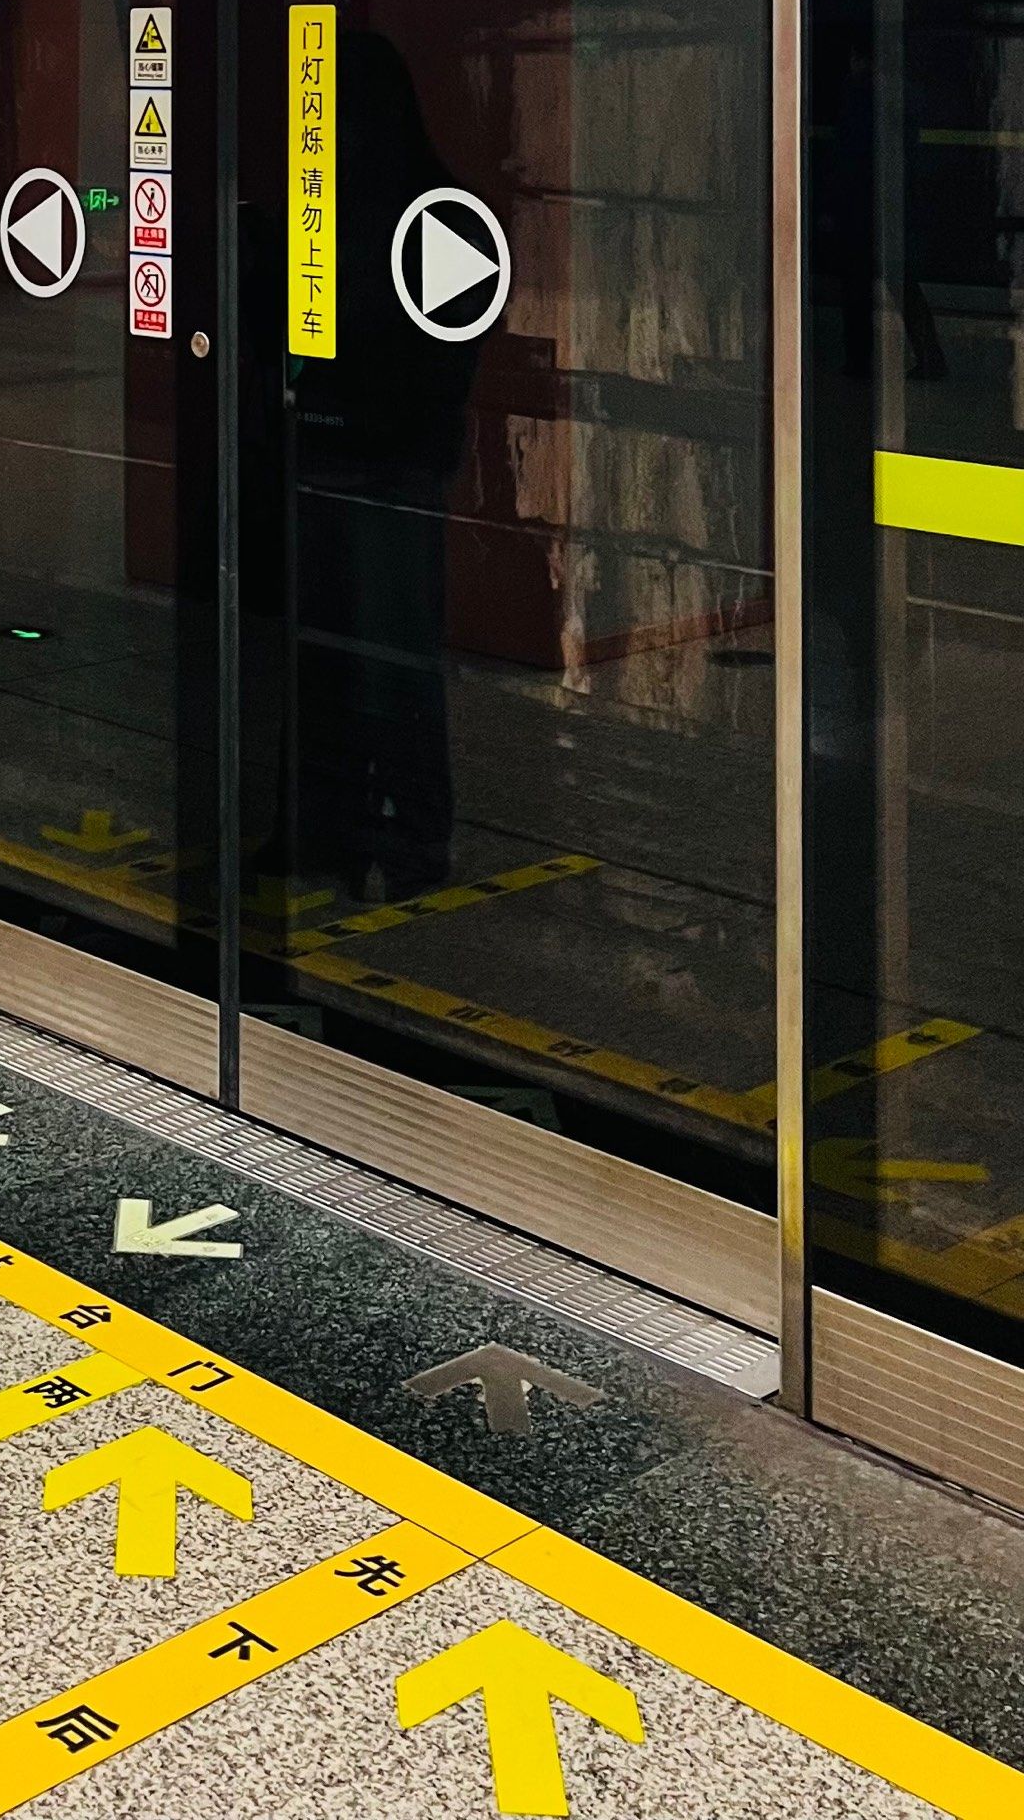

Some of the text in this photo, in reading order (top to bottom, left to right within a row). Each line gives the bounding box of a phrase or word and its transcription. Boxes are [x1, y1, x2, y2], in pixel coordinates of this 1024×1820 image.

[301, 21, 324, 339] 门灯闪烁 请勿上下车
